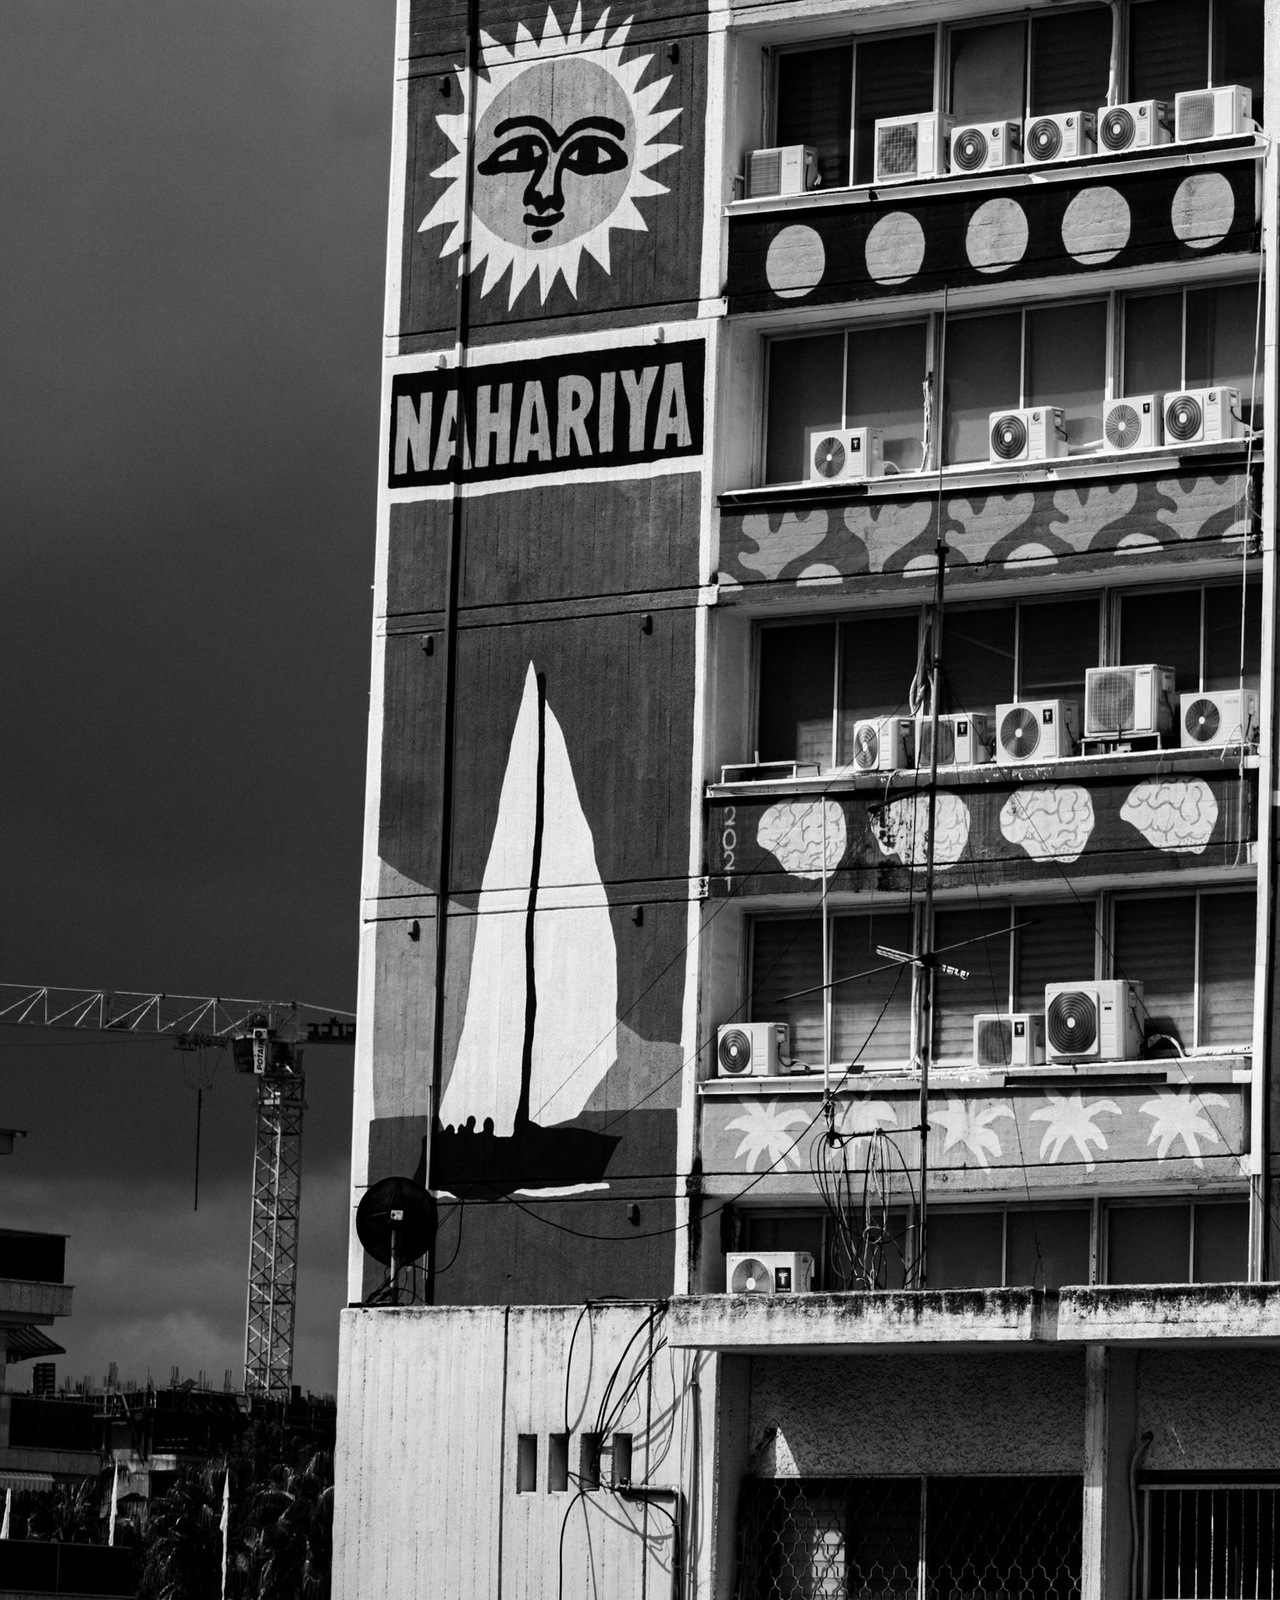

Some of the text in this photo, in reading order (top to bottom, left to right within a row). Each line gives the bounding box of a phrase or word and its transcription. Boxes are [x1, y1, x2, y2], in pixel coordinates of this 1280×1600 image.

[394, 362, 692, 475] NAHARIYA
[723, 806, 737, 892] 2021
[257, 1039, 266, 1071] POTAIN
